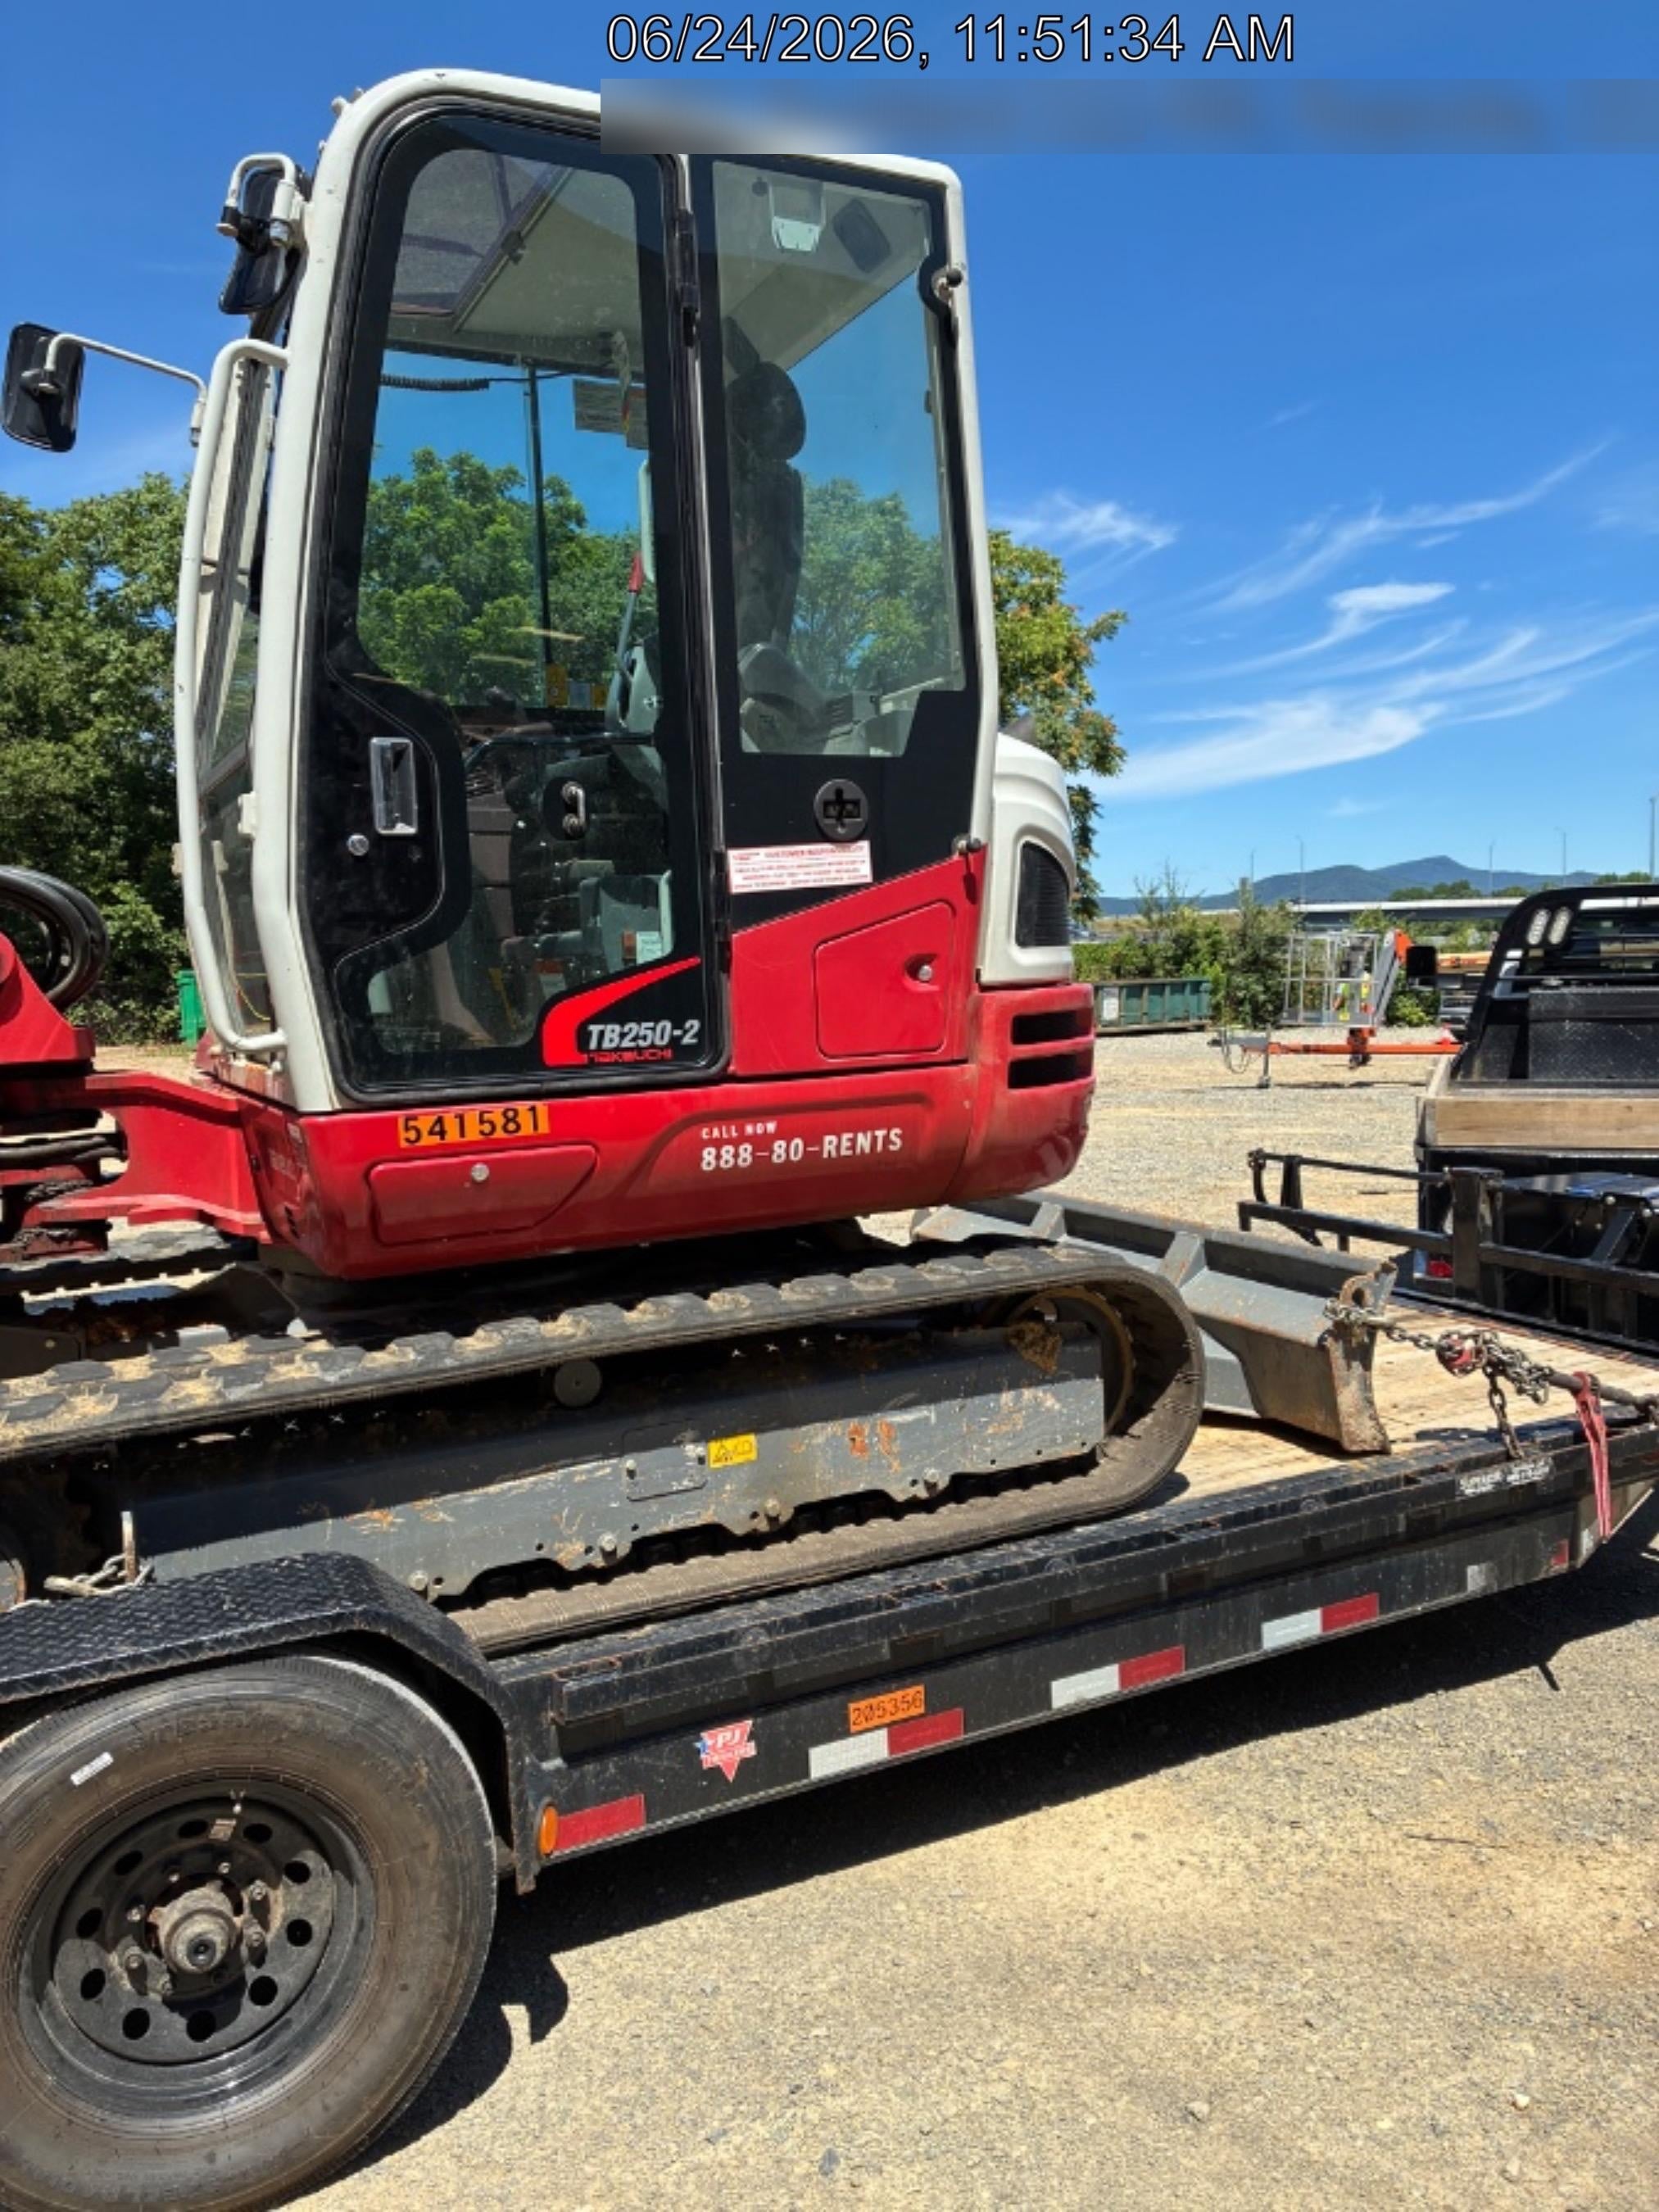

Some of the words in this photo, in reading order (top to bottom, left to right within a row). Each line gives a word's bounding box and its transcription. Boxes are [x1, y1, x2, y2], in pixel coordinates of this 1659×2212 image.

[587, 1019, 701, 1050] TB250-2
[403, 1104, 540, 1145] 541581
[701, 1124, 739, 1140] CALL
[744, 1121, 777, 1136] NOW
[701, 1127, 904, 1172] 888-80-RENTS
